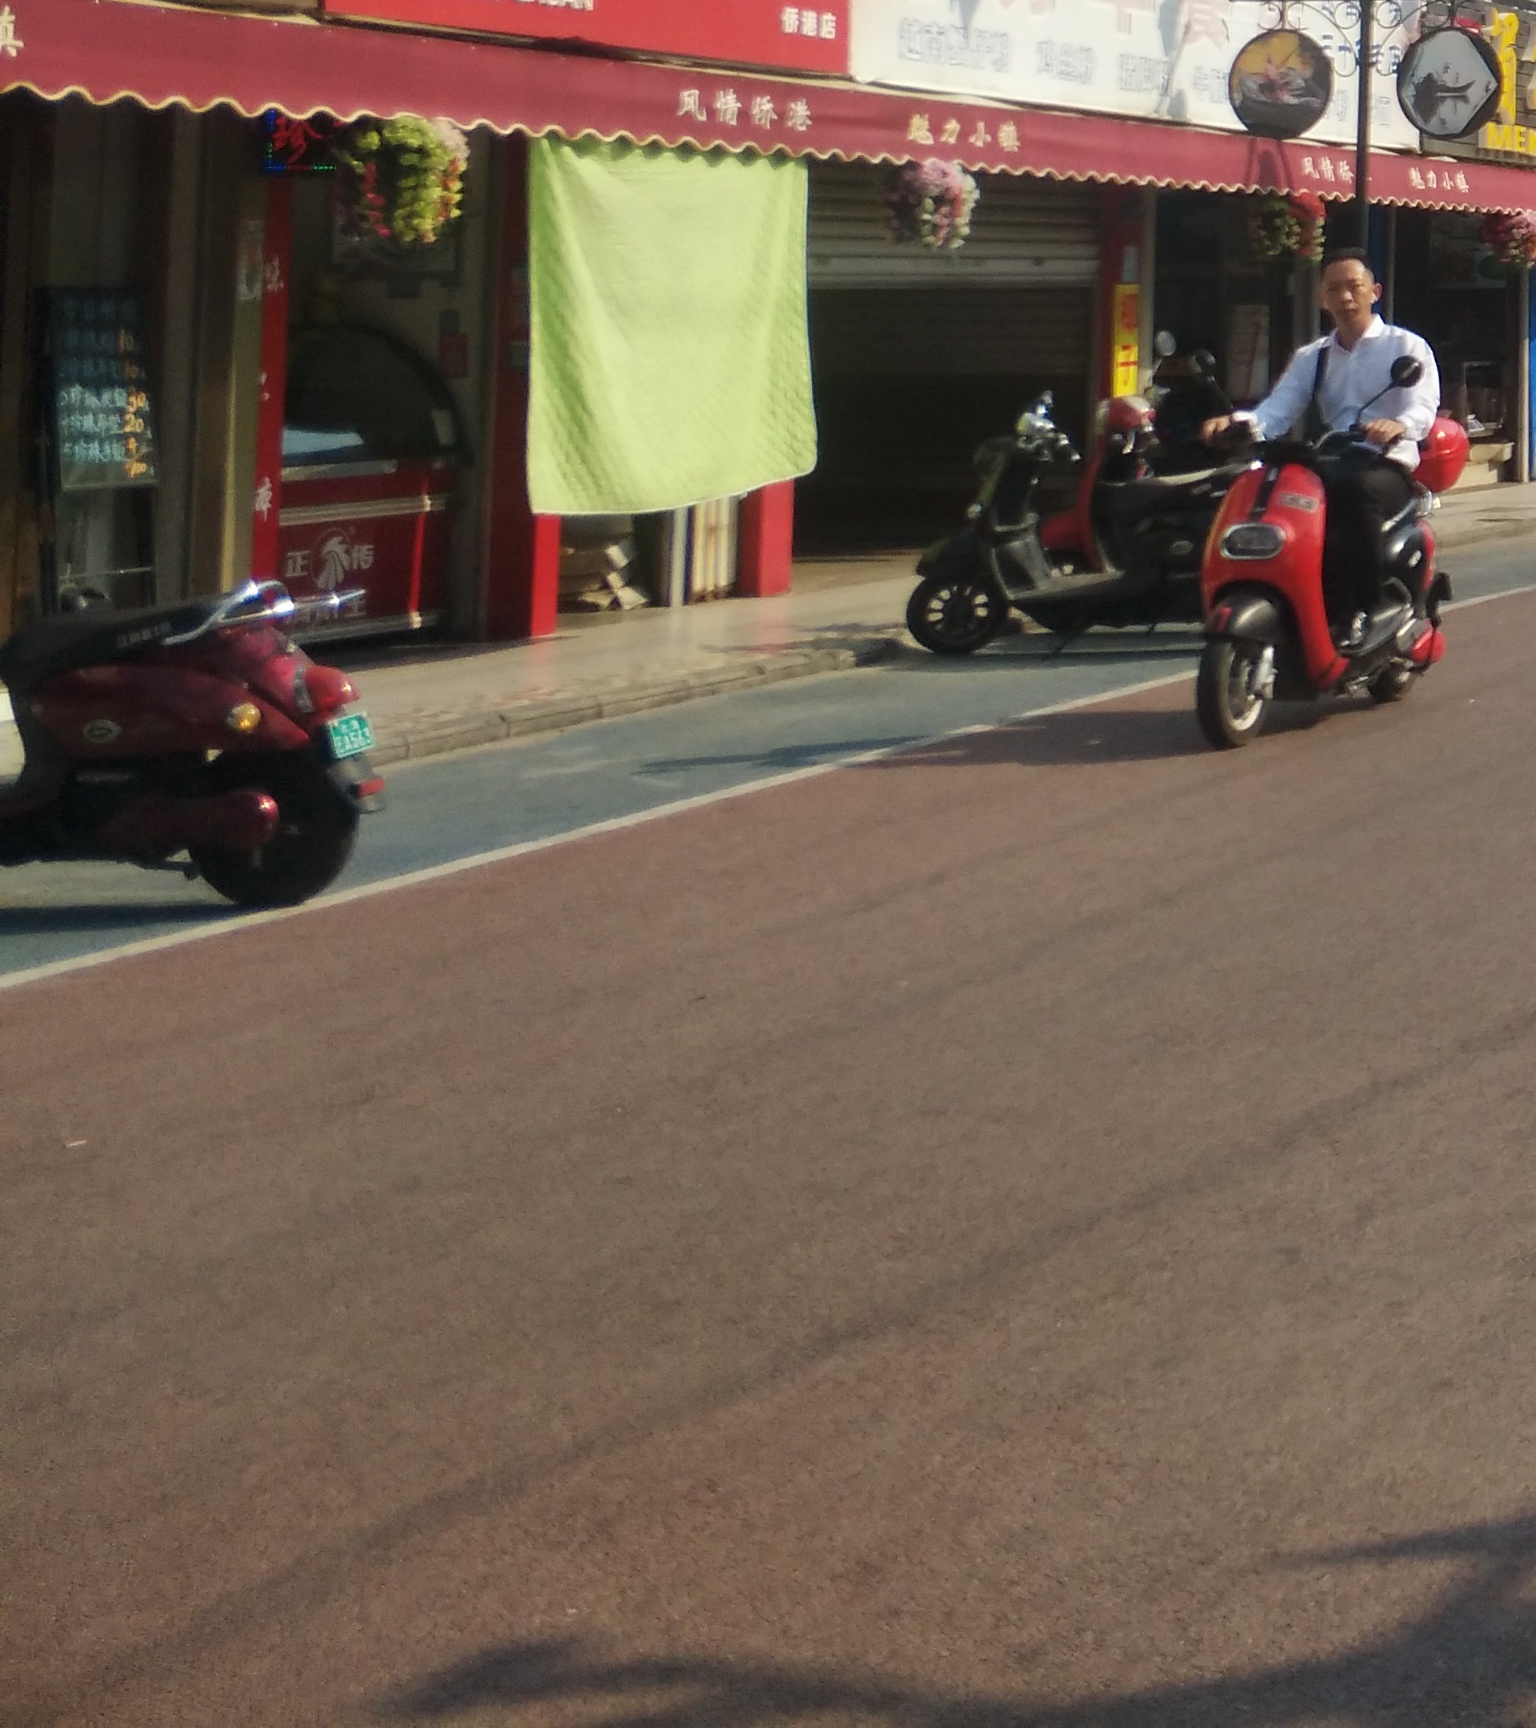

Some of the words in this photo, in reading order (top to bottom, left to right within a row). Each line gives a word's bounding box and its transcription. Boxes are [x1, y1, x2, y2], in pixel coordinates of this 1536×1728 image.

[781, 5, 837, 40] 侨港店
[675, 87, 813, 133] 风情侨港
[1301, 156, 1357, 186] 风情侨
